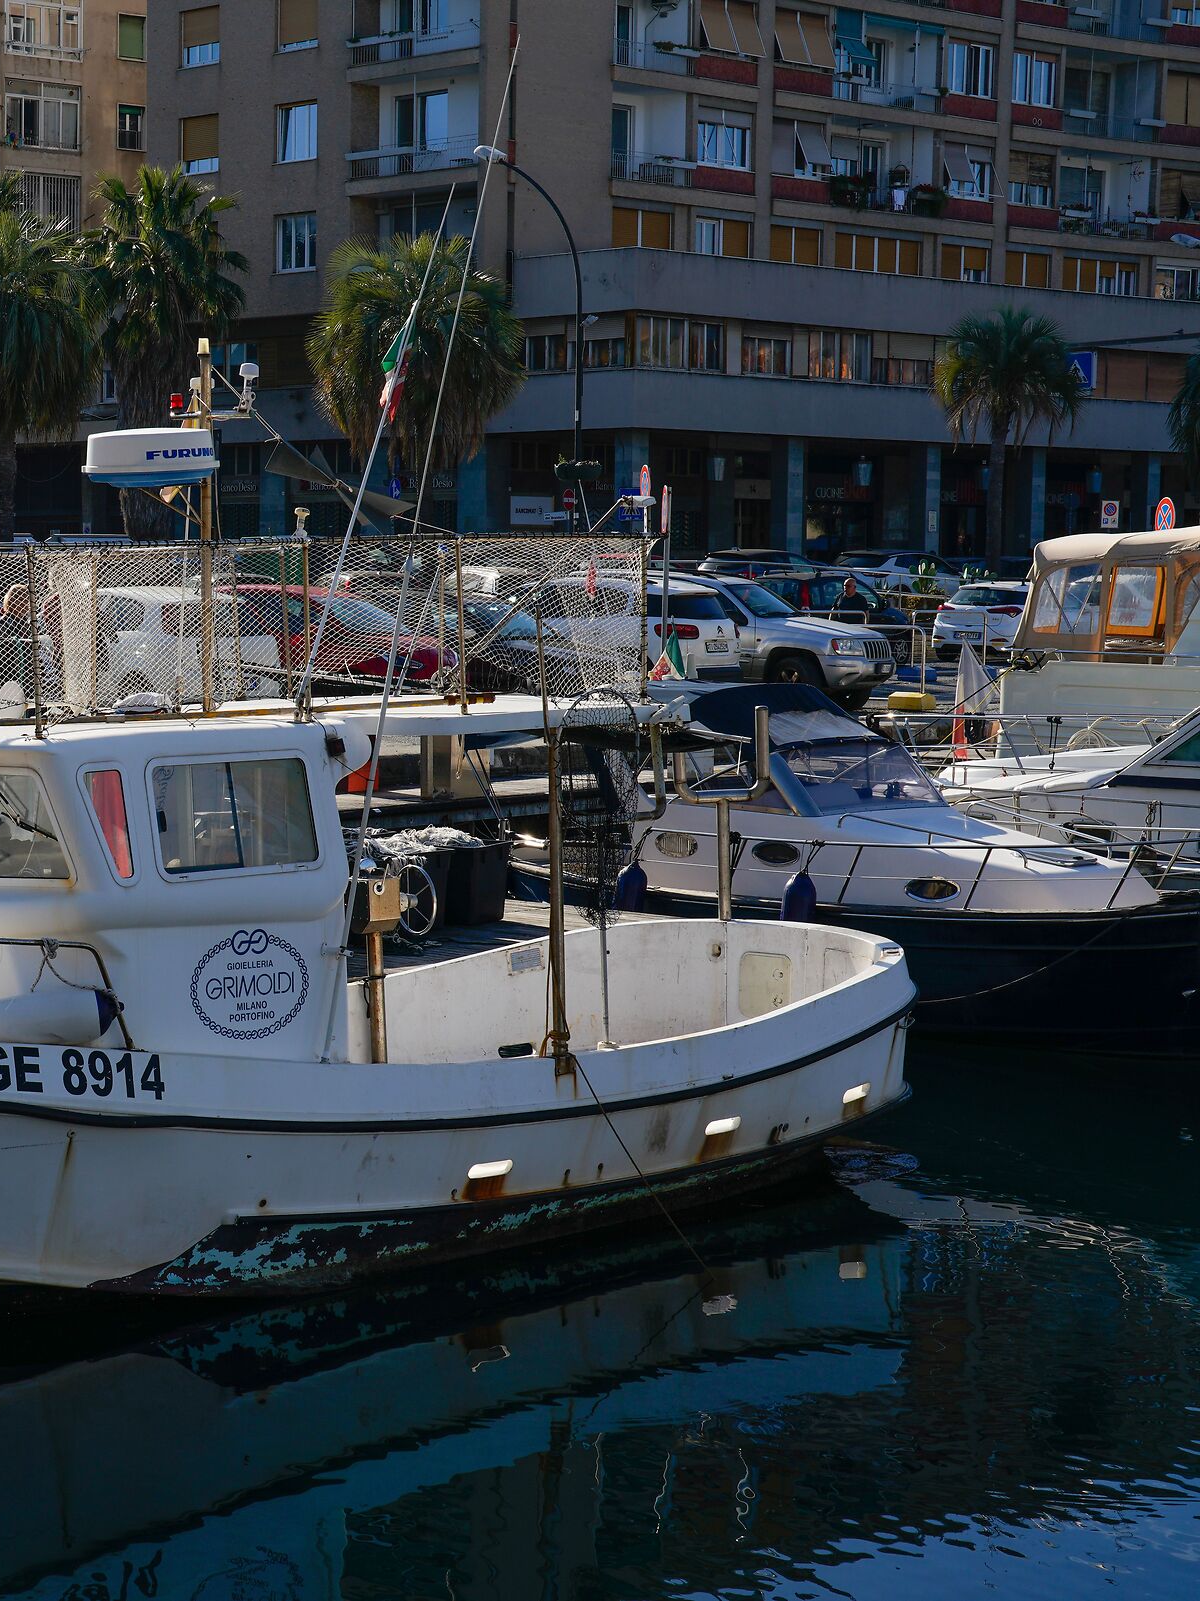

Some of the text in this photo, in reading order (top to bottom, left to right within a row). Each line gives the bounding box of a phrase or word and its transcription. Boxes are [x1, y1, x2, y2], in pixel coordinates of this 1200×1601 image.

[146, 447, 214, 460] FURUNO
[238, 480, 257, 492] Desio
[815, 487, 845, 499] CUCINE
[226, 959, 274, 971] GIOIELLERIA
[205, 971, 295, 1000] GRIMOLDI
[236, 1000, 268, 1011] MILANO
[229, 1010, 275, 1023] PORTOFINO
[62, 1049, 165, 1101] 8914
